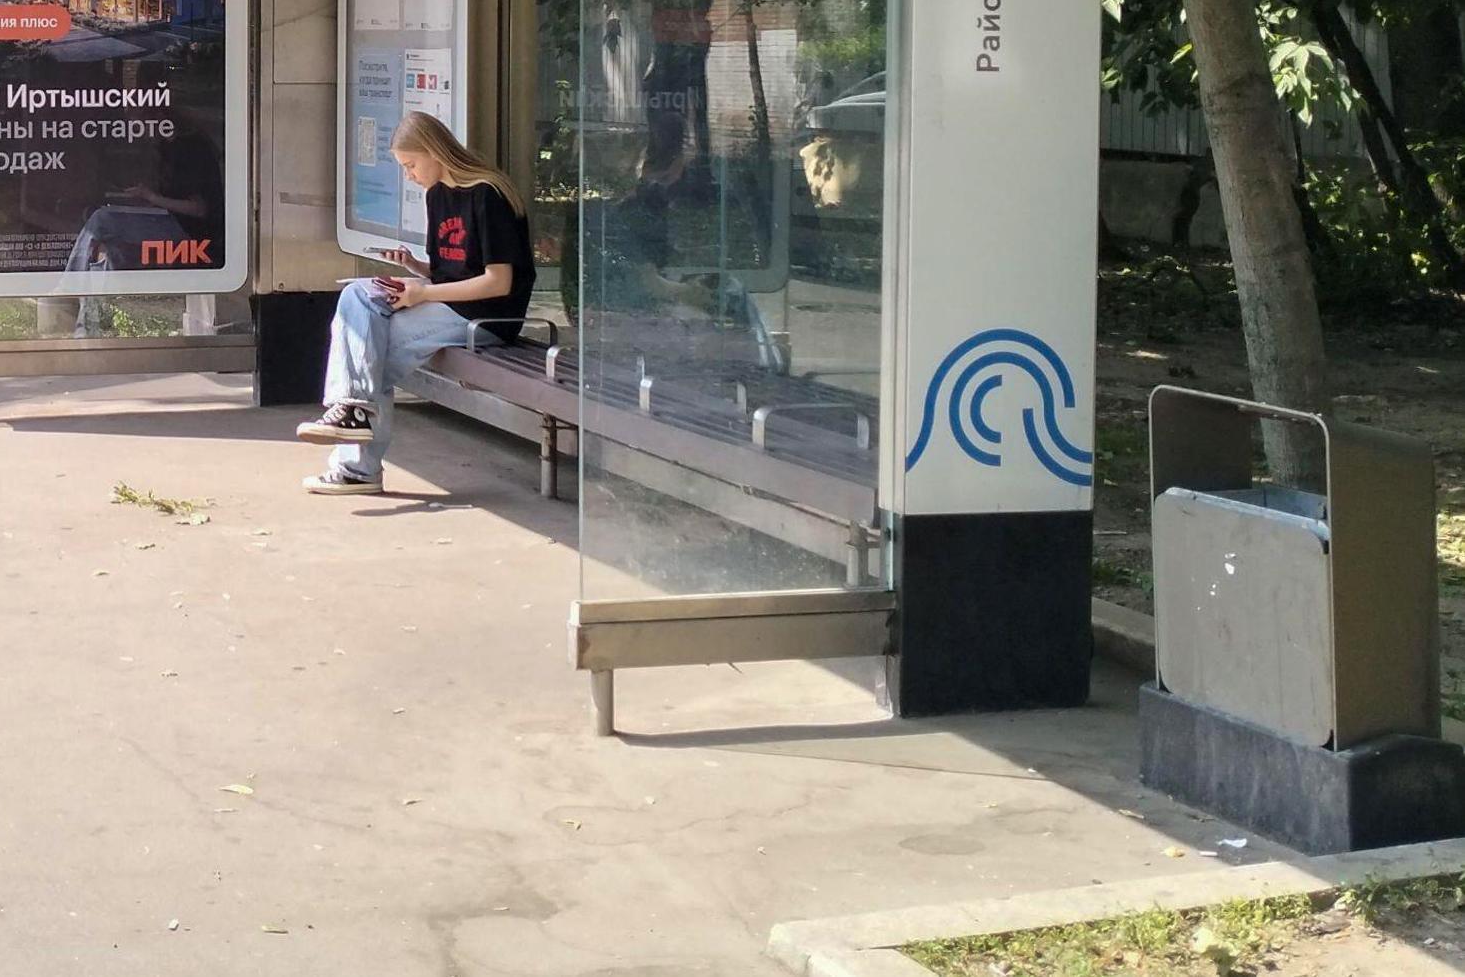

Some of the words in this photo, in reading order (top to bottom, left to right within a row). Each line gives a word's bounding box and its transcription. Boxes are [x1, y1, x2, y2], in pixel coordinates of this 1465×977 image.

[20, 16, 59, 29] плюс
[6, 81, 171, 113] Иртышский
[41, 120, 74, 139] на
[81, 118, 175, 144] старте
[141, 239, 212, 265] ПИК
